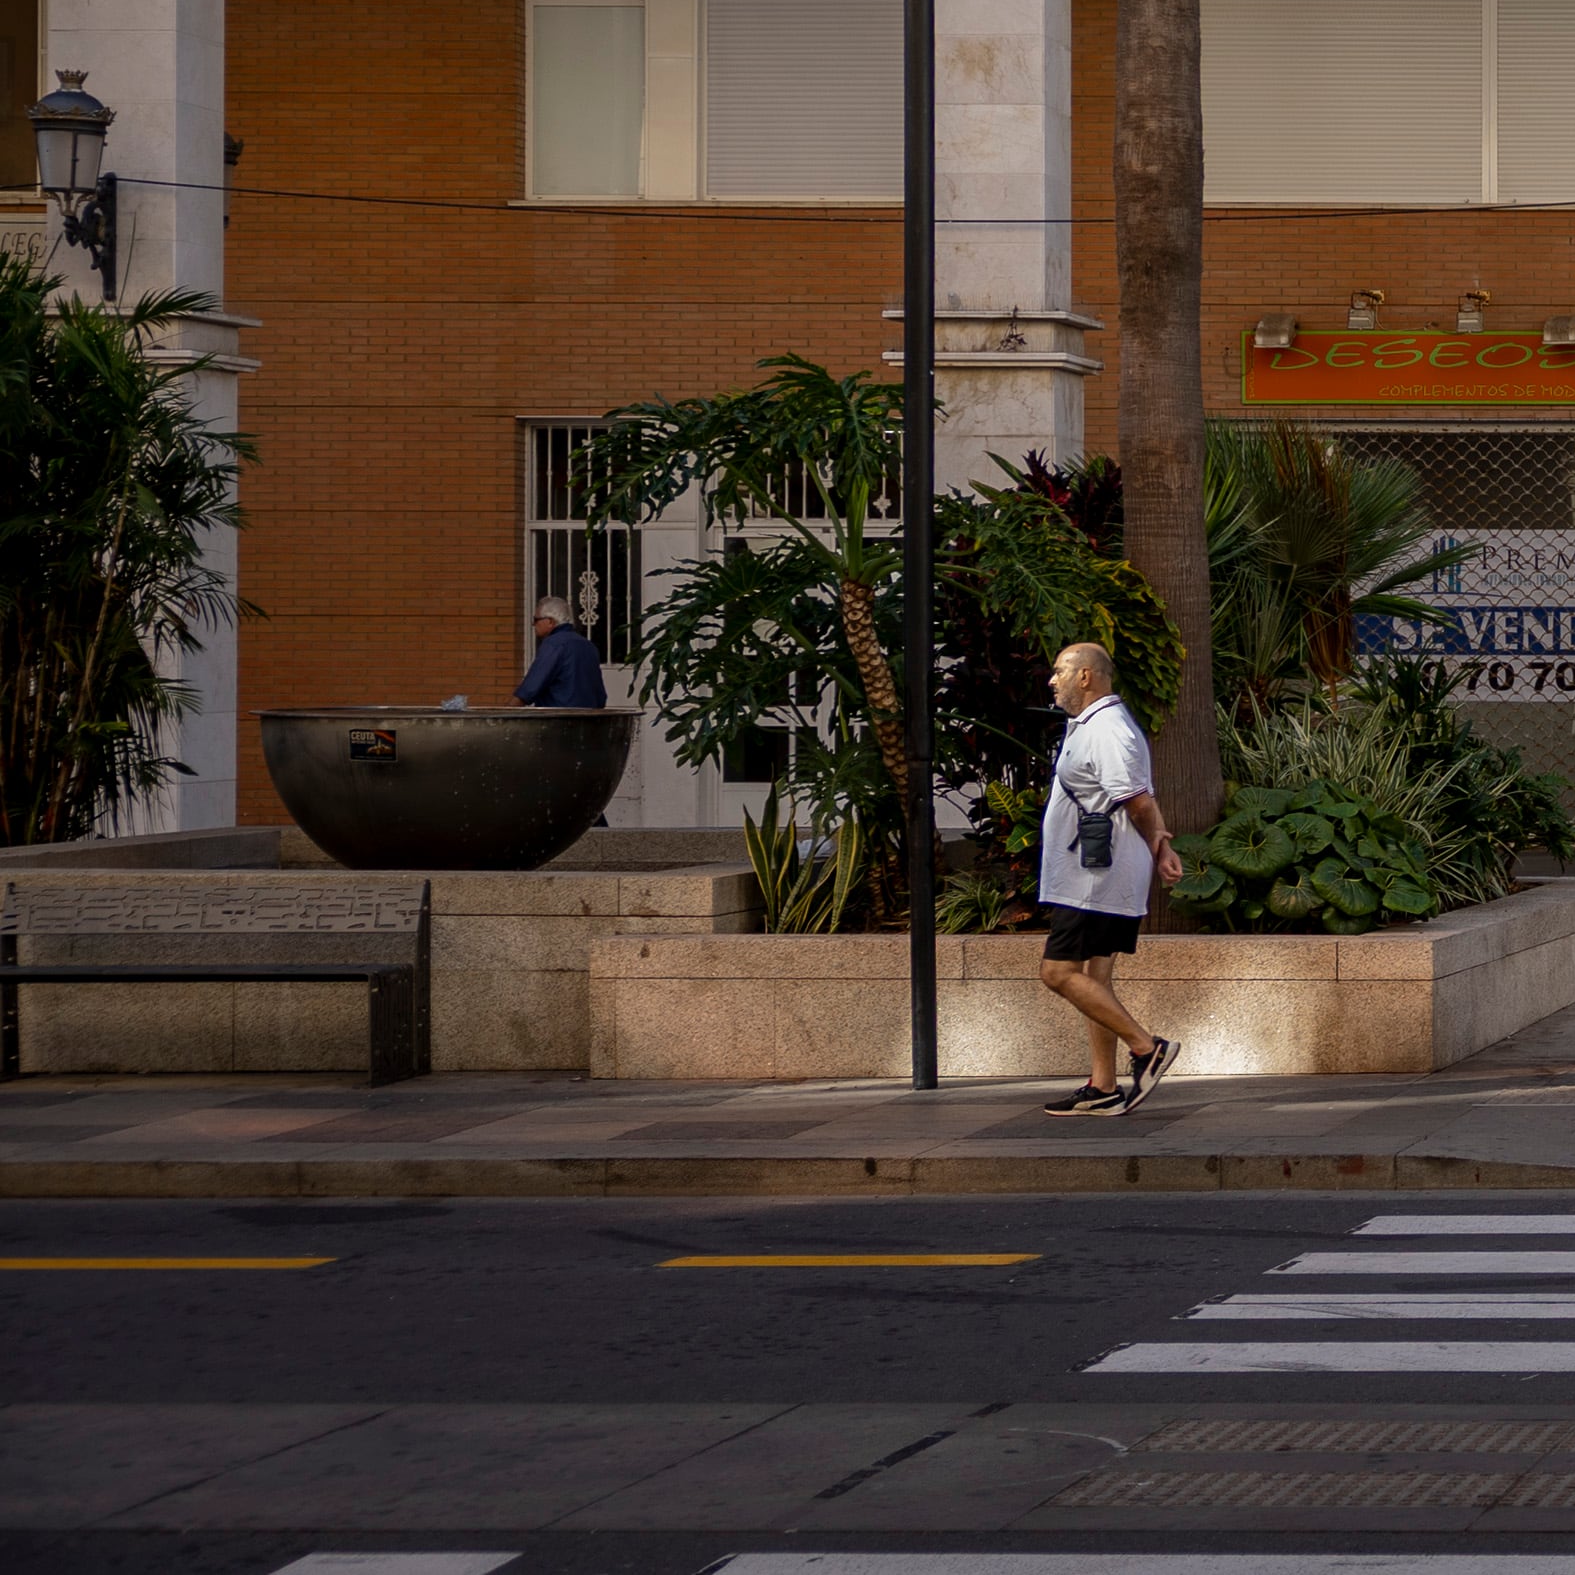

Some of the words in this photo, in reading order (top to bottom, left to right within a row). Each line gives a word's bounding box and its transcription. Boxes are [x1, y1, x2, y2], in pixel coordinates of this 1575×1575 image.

[1378, 383, 1509, 398] COMPLEMENTOS
[1512, 383, 1536, 398] DE
[1461, 661, 1515, 692] 70
[351, 730, 376, 741] CEUTA
